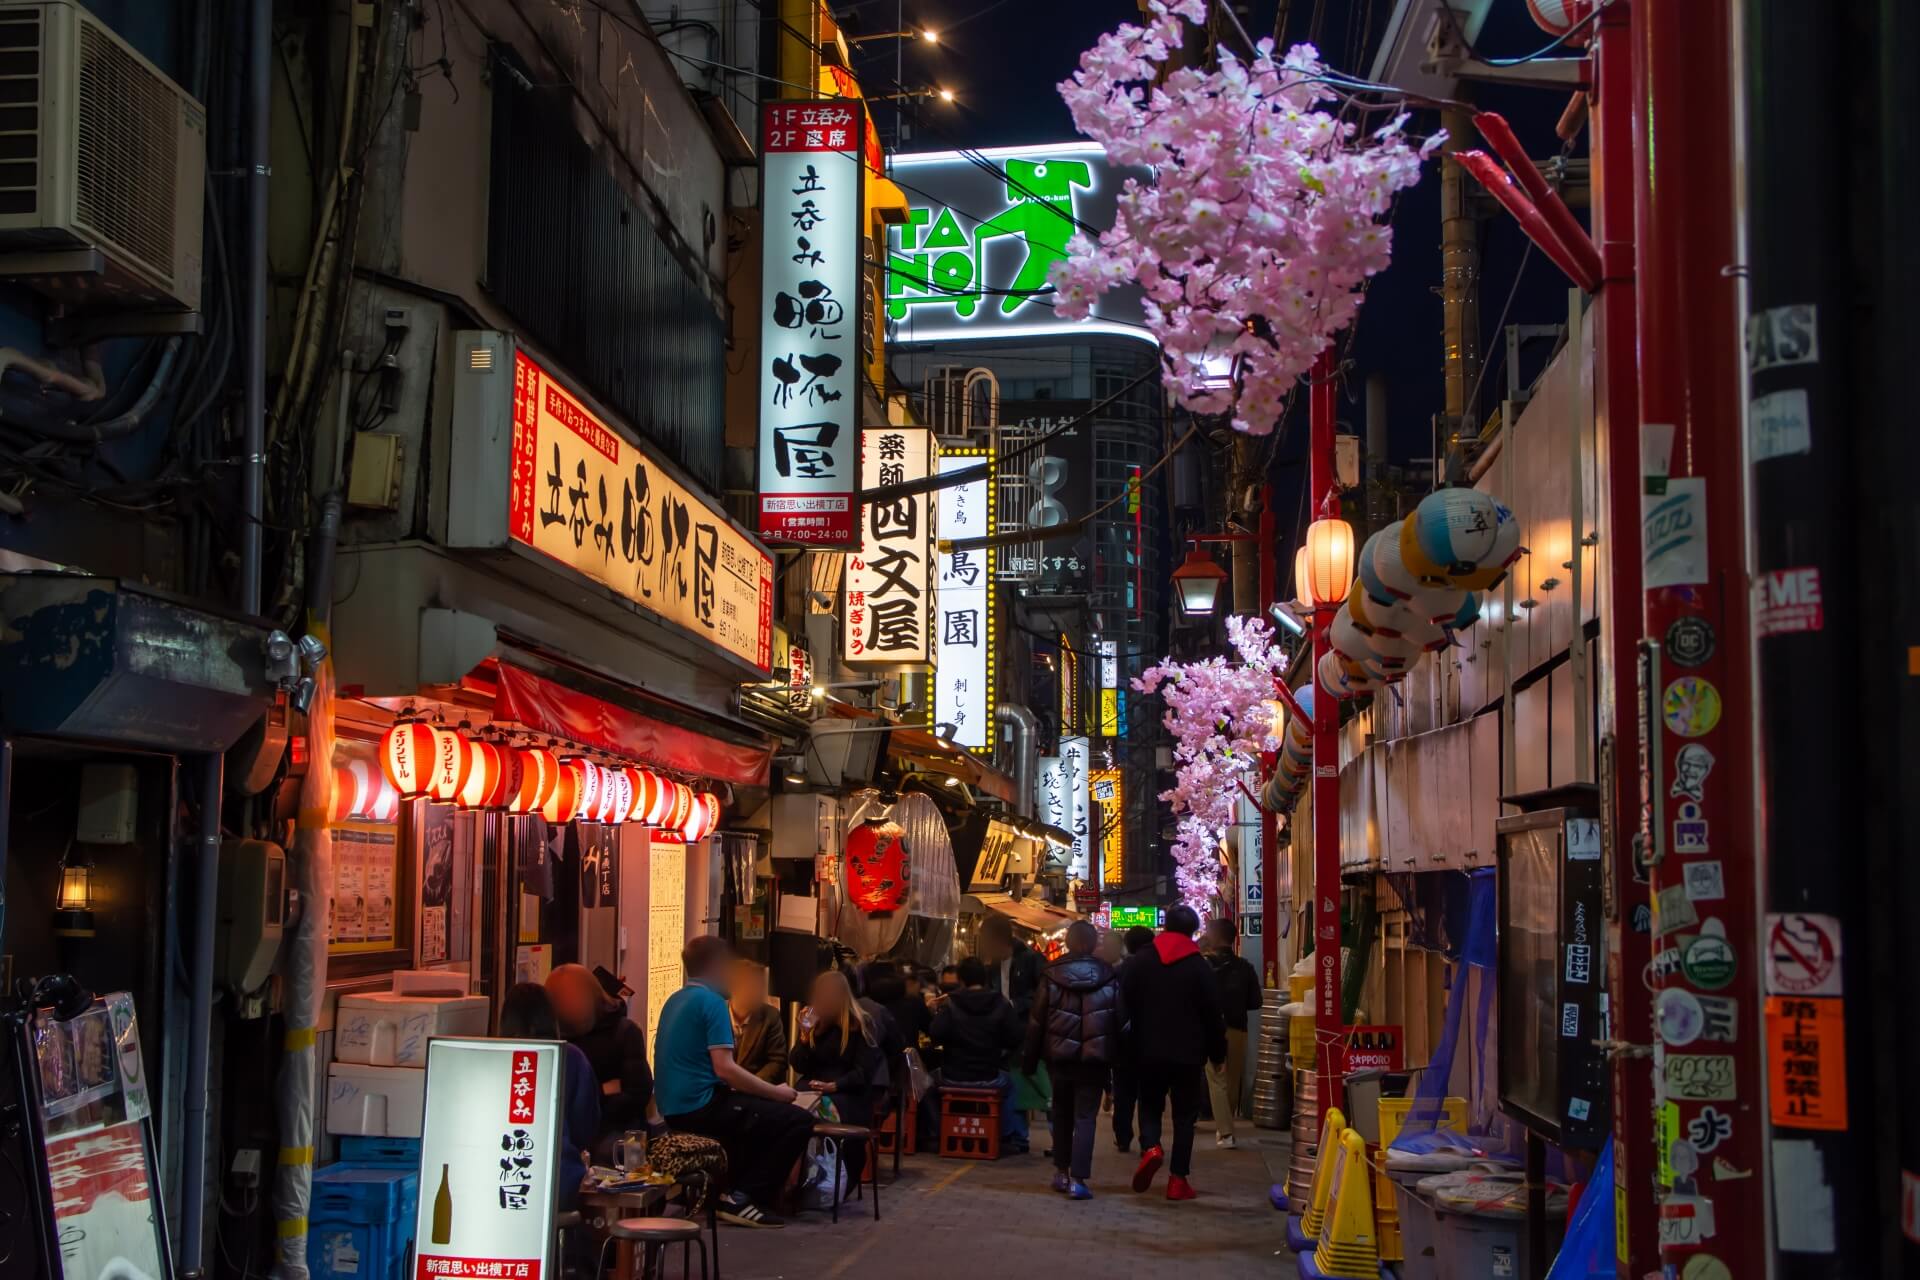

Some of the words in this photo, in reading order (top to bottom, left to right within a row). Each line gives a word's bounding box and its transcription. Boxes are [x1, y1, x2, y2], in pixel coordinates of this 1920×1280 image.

[770, 130, 797, 147] 2F
[805, 129, 846, 147] 座席
[522, 367, 536, 539] 新鮮おつまみ
[766, 499, 846, 511] 新宿思い出横丁店
[953, 678, 968, 725] 刺し身
[395, 730, 410, 778] キリンビール
[442, 736, 454, 784] キリンビール
[513, 1056, 534, 1119] 立呑み
[426, 1259, 529, 1277] 新宿思い出横丁店
